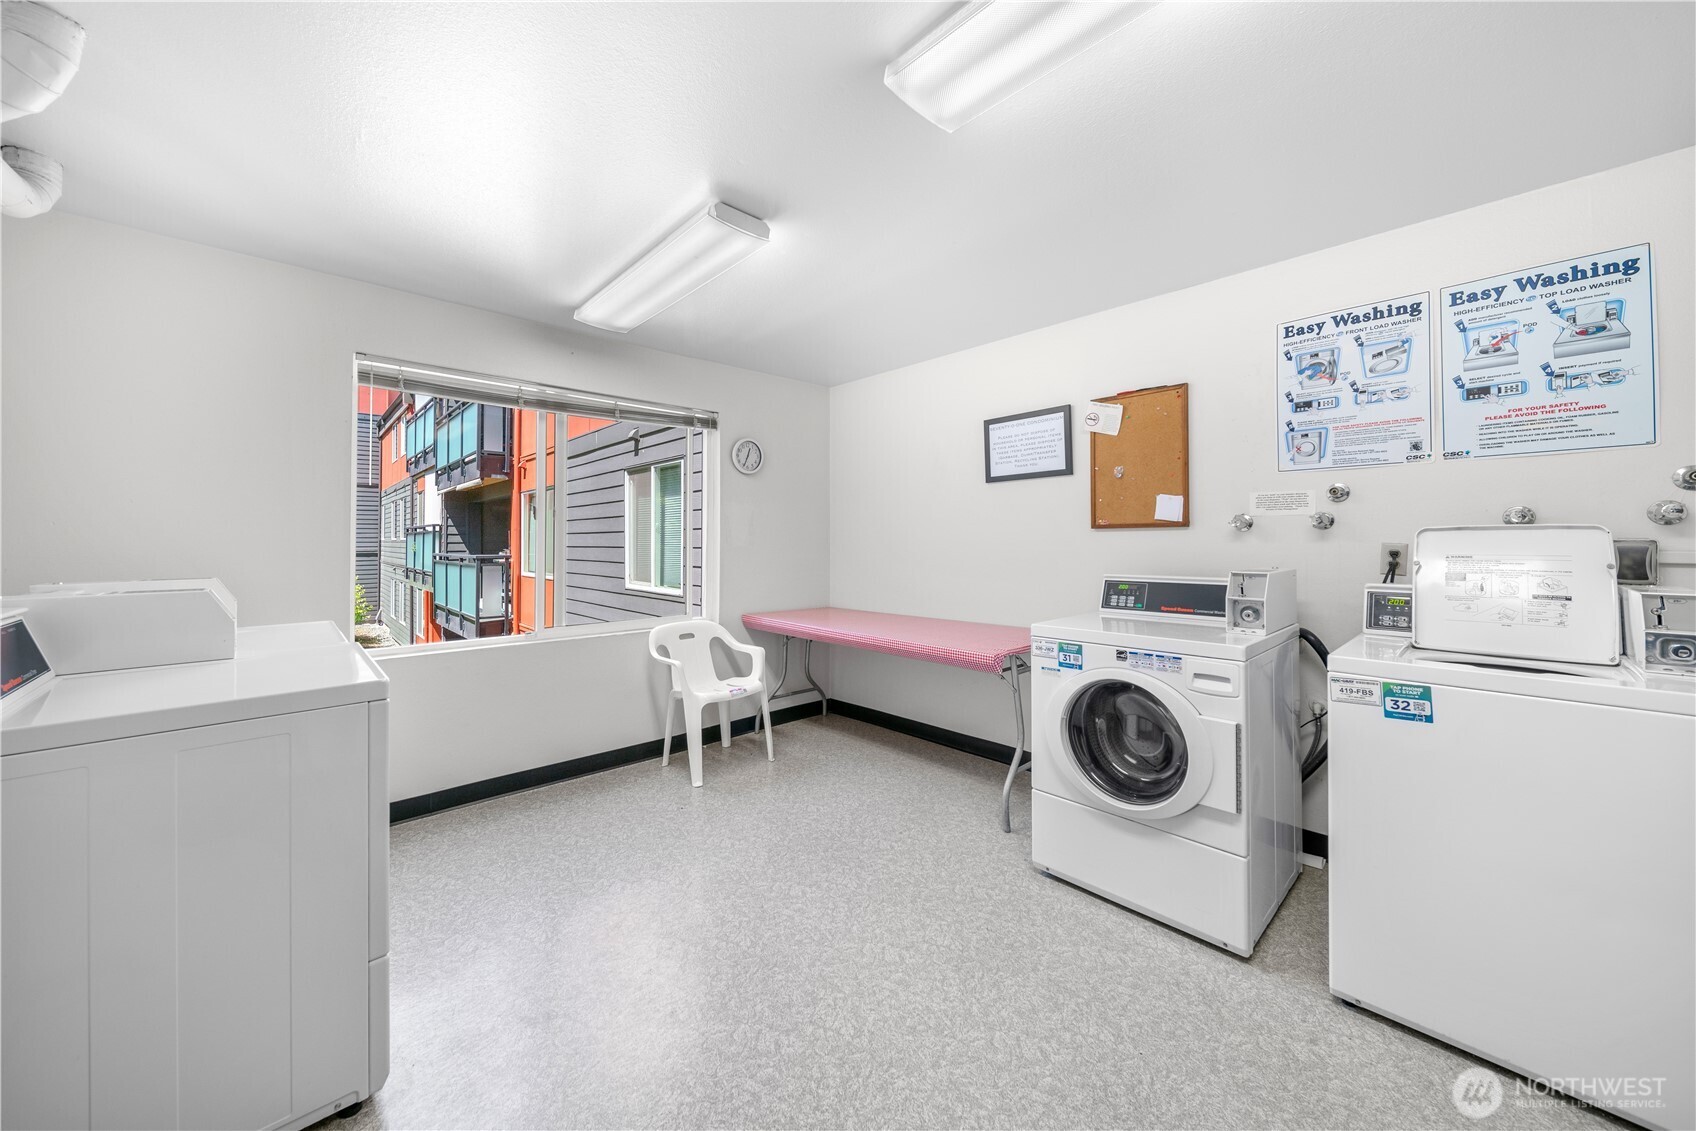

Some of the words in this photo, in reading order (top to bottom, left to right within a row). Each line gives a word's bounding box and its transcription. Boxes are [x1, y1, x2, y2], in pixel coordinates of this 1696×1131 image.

[1448, 284, 1508, 307] Easy
[1513, 257, 1642, 293] Washing
[1454, 298, 1524, 316] HIGH-EFFICIENCY
[1539, 291, 1558, 300] TOP
[1560, 285, 1587, 296] LOAD
[1589, 277, 1632, 290] WASHER
[1283, 321, 1326, 339] Easy
[1330, 301, 1422, 328] Washing
[1283, 333, 1335, 348] HIGH-EFFICIENCY
[1345, 327, 1368, 335] FRONT
[1370, 322, 1389, 331] LOAD
[1391, 316, 1422, 327] WASHER
[1549, 401, 1580, 409] SAFETY
[1558, 404, 1607, 413] FOLLOWING
[1027, 416, 1064, 425] CONDOMINIUM
[1062, 654, 1071, 662] 31
[1339, 688, 1374, 696] 419-FBS
[1390, 699, 1411, 711] 32
